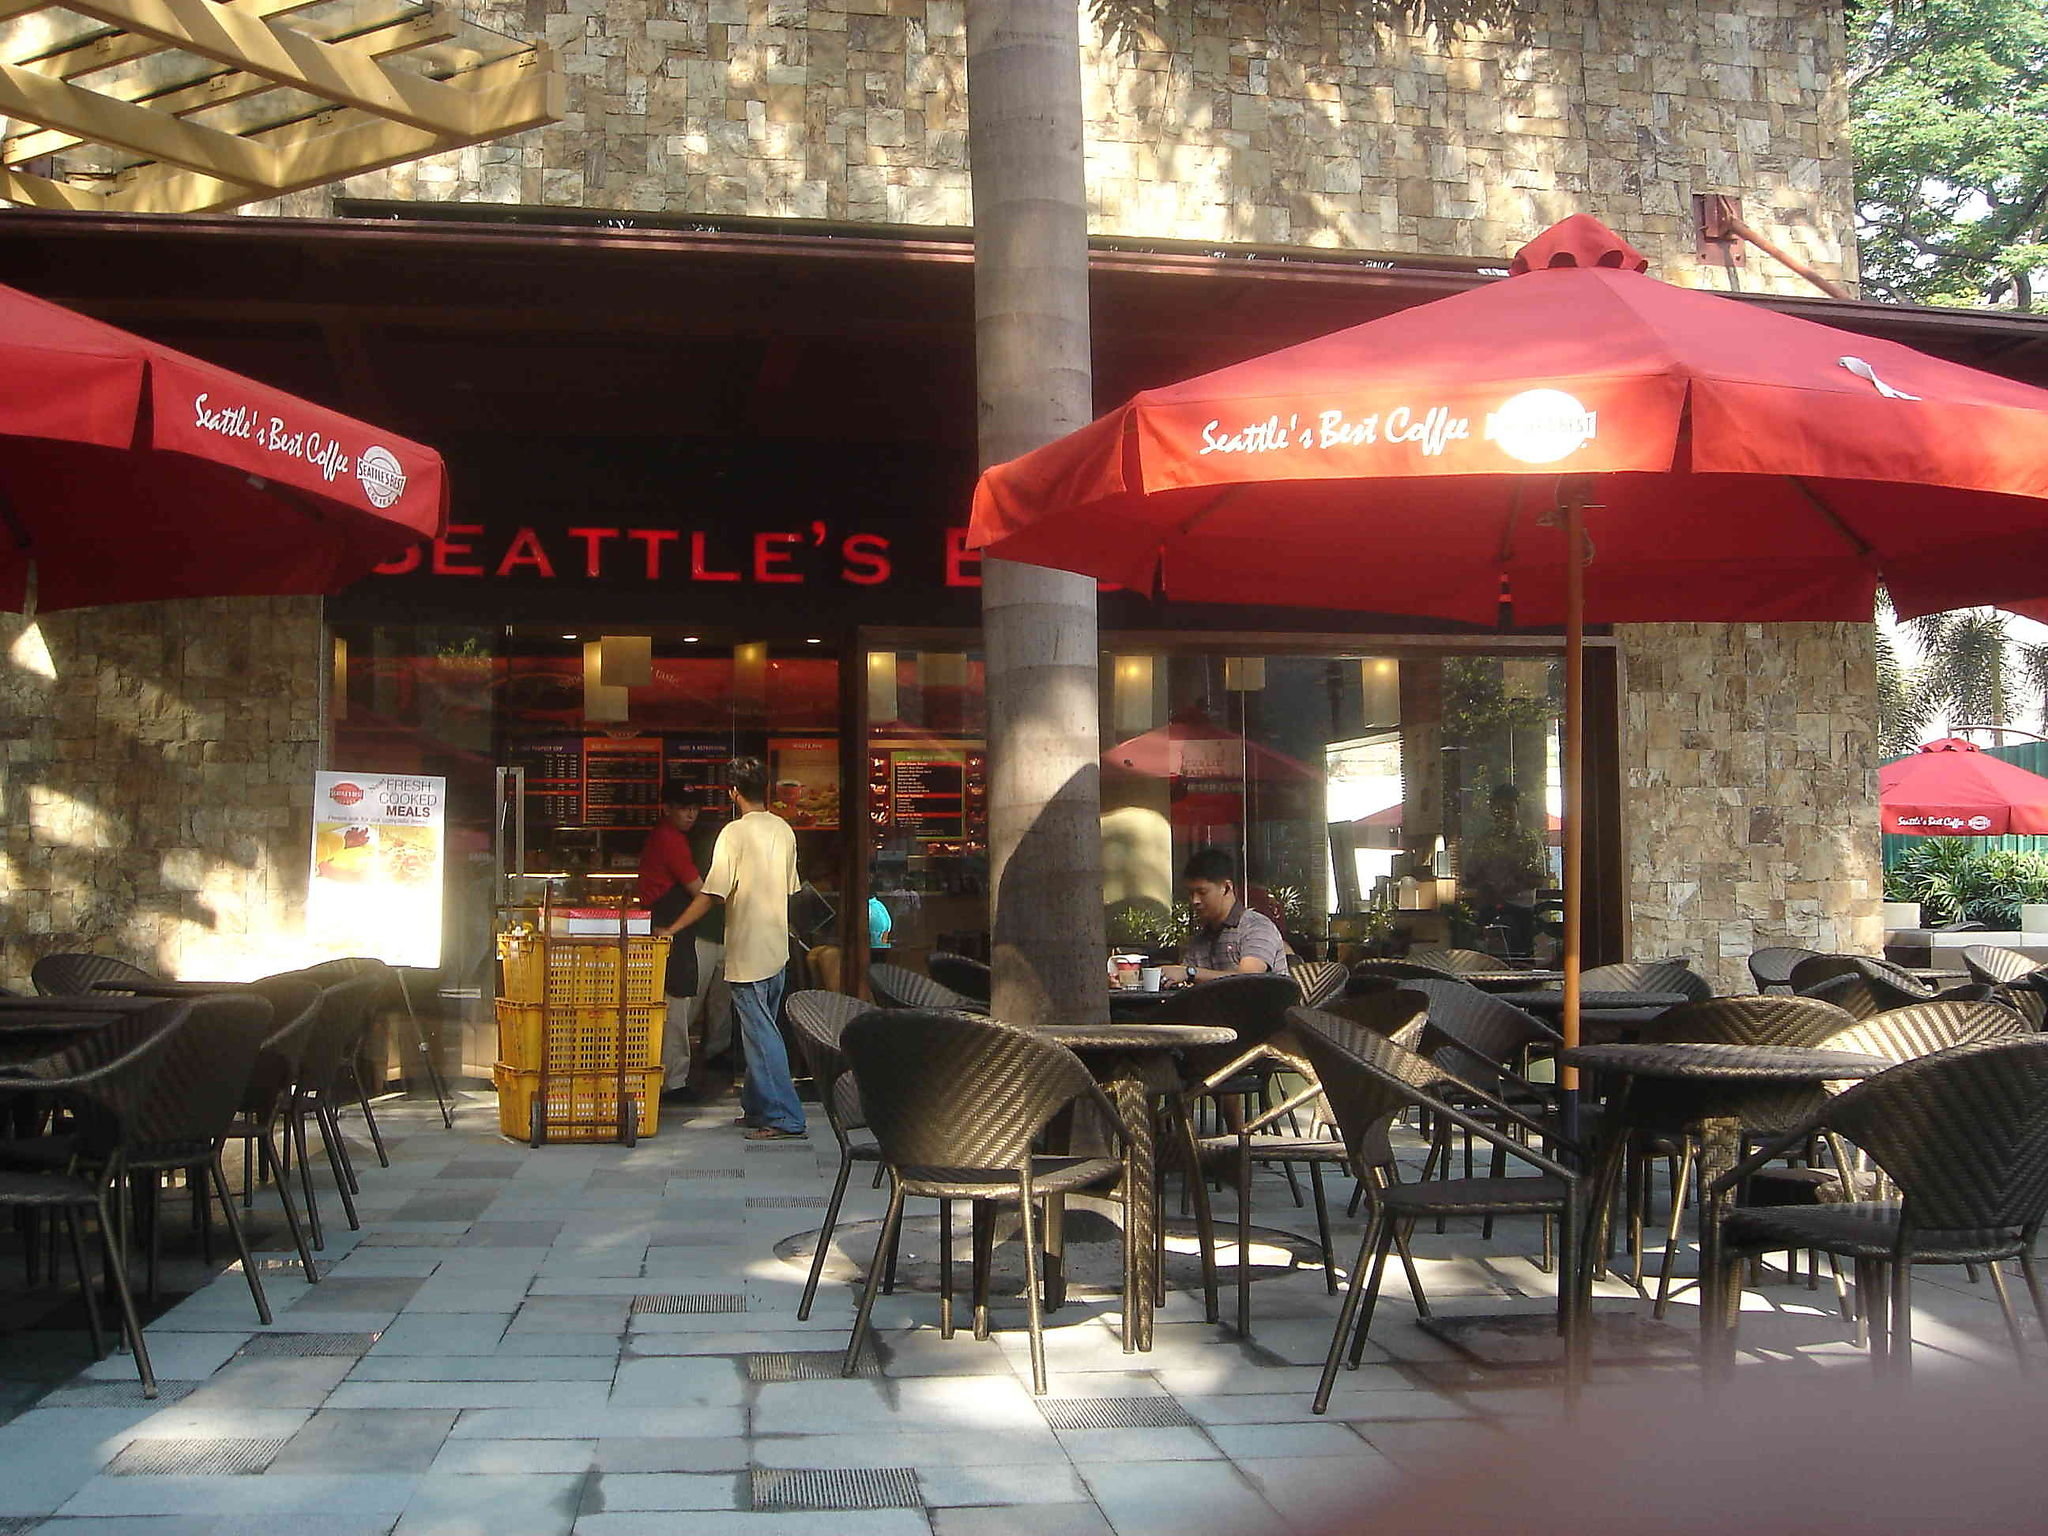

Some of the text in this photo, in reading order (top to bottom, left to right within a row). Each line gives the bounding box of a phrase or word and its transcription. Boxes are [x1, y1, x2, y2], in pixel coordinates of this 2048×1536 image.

[195, 393, 349, 482] Seattle's Best Coffee
[1199, 413, 1312, 455] Seattle's
[1318, 410, 1378, 449] Best
[1385, 406, 1470, 456] Coffee
[386, 779, 432, 793] FRESH
[379, 792, 437, 806] COOKED
[386, 806, 431, 818] MEALS
